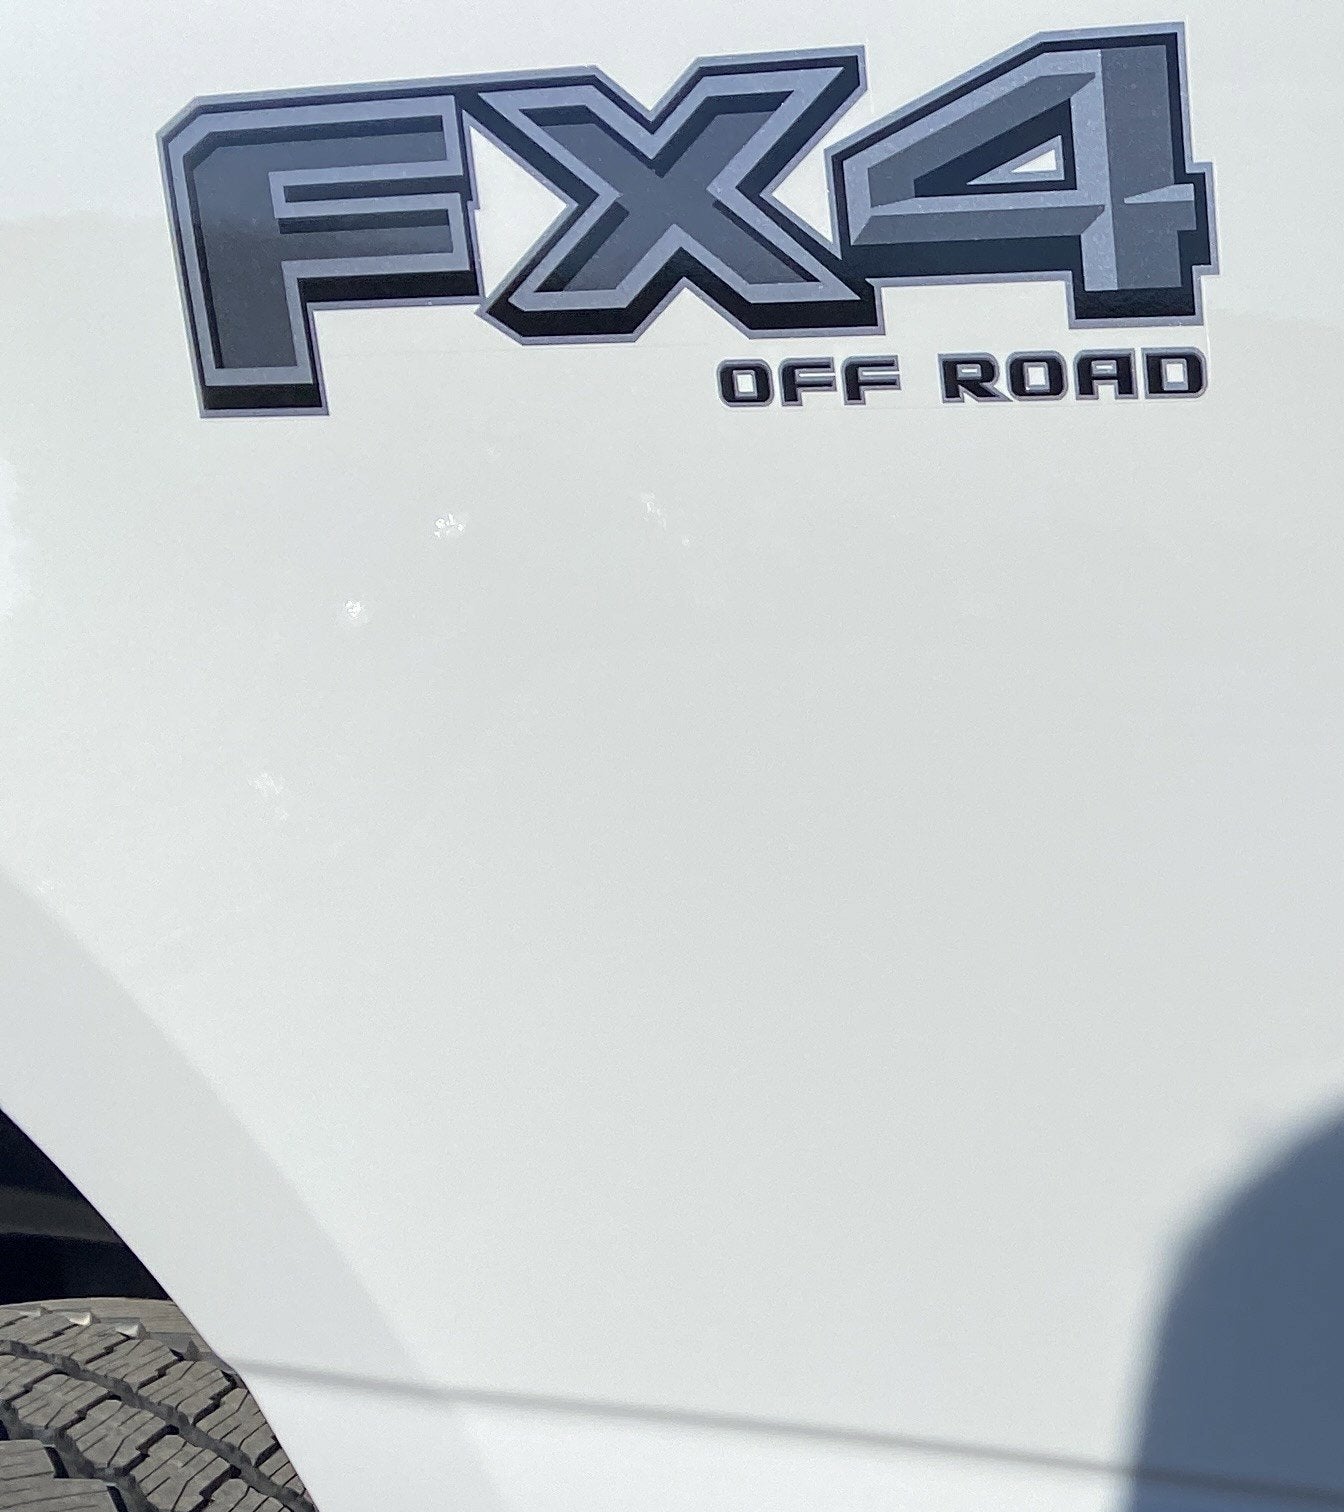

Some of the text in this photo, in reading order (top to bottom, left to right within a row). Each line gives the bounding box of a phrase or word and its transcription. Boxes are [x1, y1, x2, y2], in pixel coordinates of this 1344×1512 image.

[158, 23, 1218, 417] FX4
[717, 348, 1209, 406] OFF ROAD
